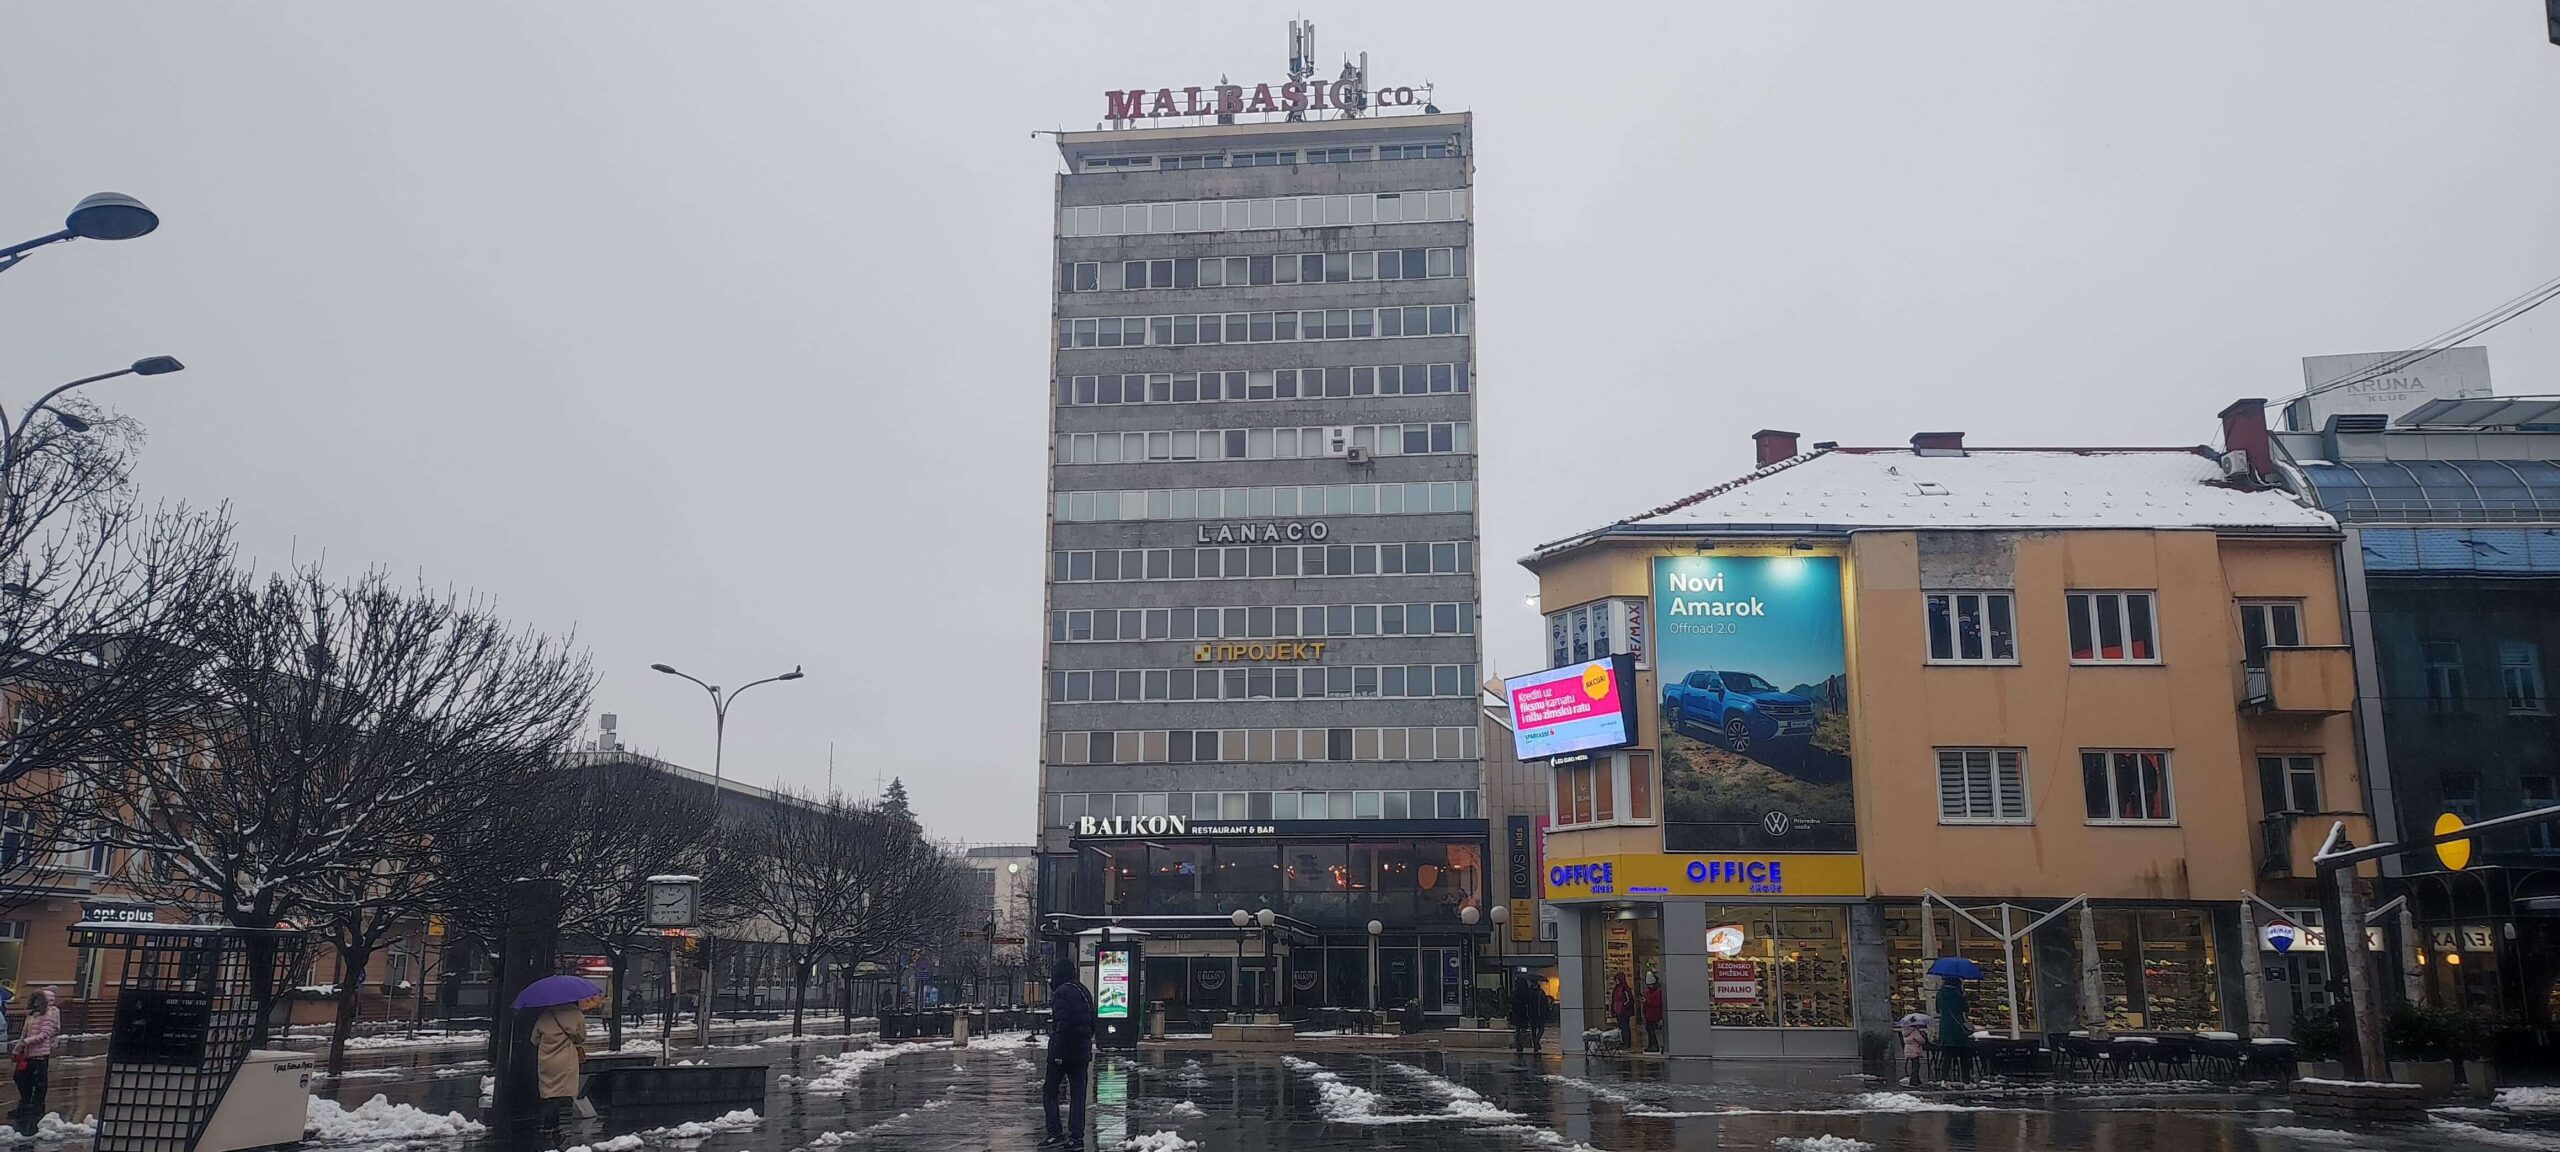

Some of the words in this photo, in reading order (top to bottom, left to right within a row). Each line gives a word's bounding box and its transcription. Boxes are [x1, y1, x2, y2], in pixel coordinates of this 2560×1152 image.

[2346, 377, 2424, 393] KRUNA
[2368, 394, 2407, 402] KLUB
[1197, 521, 1329, 543] LANACO
[1669, 572, 1724, 592] Novi
[1669, 596, 1765, 616] Amarok
[1628, 605, 1642, 662] RE/MAX
[1669, 622, 1713, 634] Offroad
[1717, 623, 1736, 634] 2.0
[1217, 642, 1326, 662] ПРОЈЕКТ
[1518, 689, 1543, 702] Krediti
[1545, 695, 1576, 708] kamatu
[1521, 713, 1526, 723] i
[1573, 702, 1591, 714] ratu
[1080, 815, 1187, 835] BALKON
[1191, 826, 1247, 834] RESTAURANT
[1248, 826, 1255, 834] &
[1257, 826, 1275, 834] BAR
[1515, 827, 1524, 846] kids
[1550, 862, 1613, 886] OFFICE
[1687, 860, 1782, 883] OFFICE
[1590, 885, 1613, 894] SHOES
[1749, 884, 1783, 893] SHOES
[1716, 962, 1752, 970] SEZONSKO
[1718, 969, 1749, 977] SNIŽENJE
[1717, 985, 1752, 994] FINALNO
